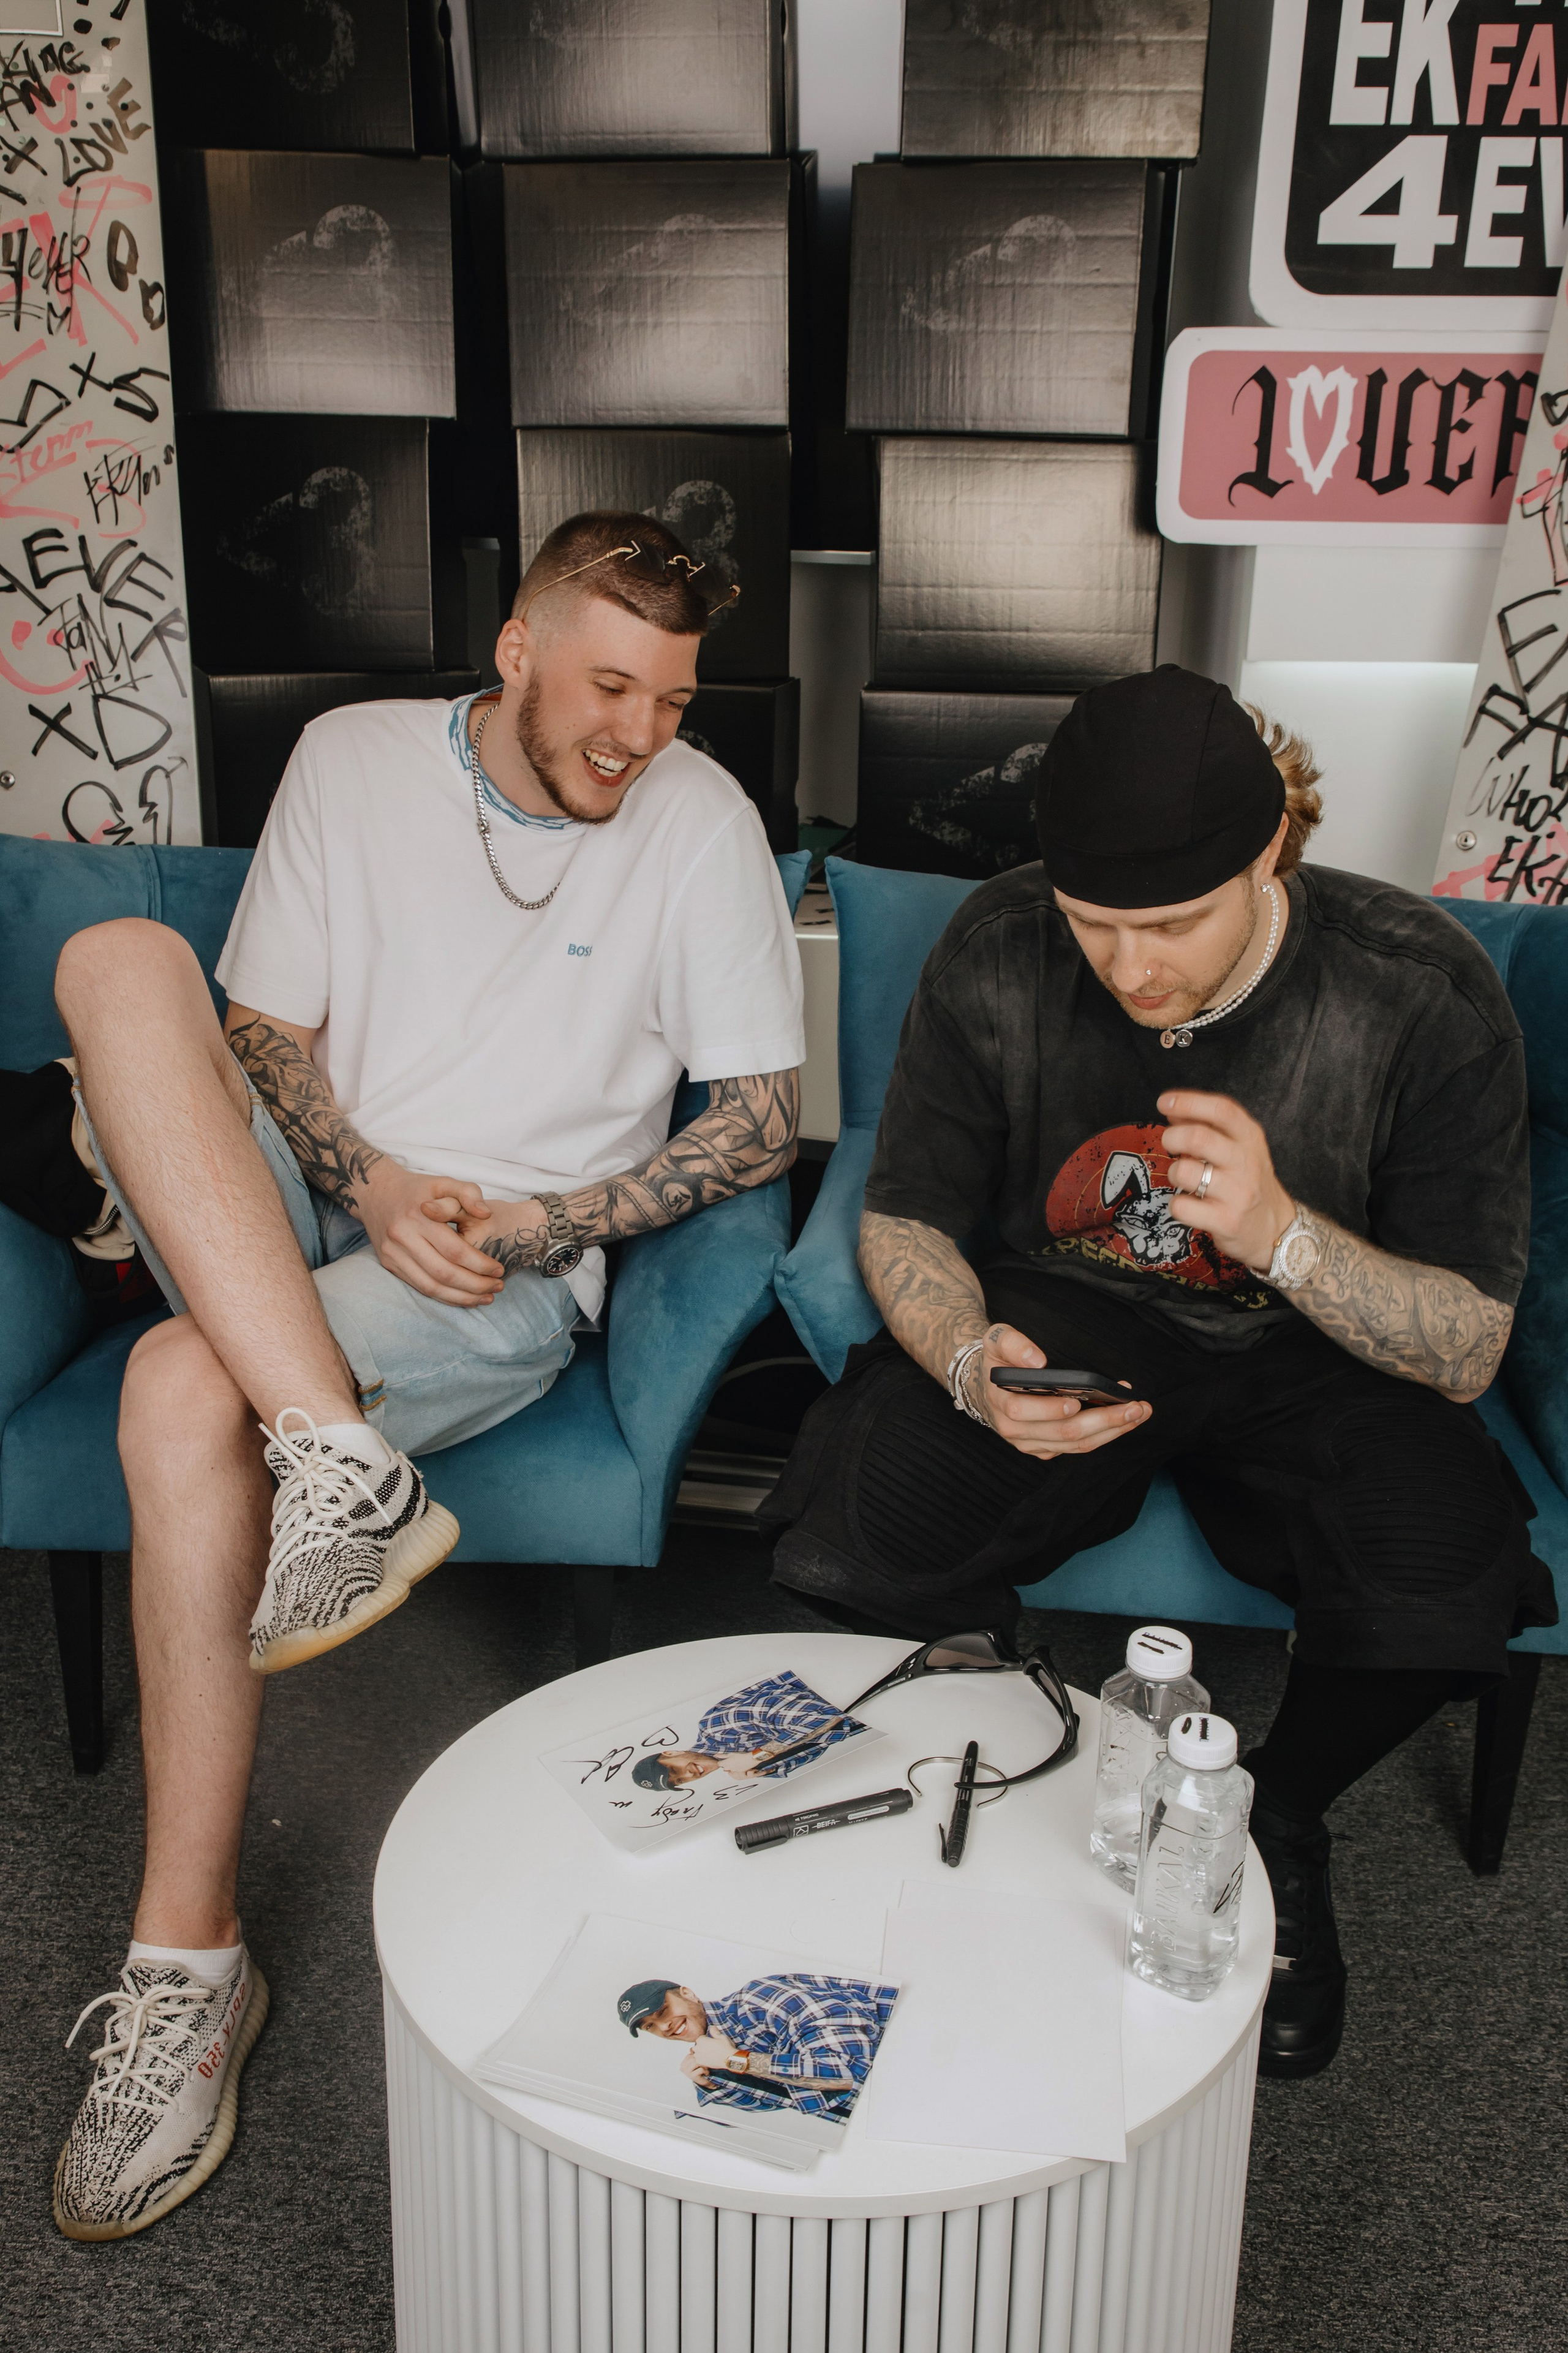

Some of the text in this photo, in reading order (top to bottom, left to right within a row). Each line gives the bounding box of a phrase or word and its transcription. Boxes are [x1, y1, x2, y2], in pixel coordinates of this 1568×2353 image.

[1466, 23, 1568, 126] FA
[59, 77, 151, 187] LOVE
[816, 1819, 836, 1829] BEIFA
